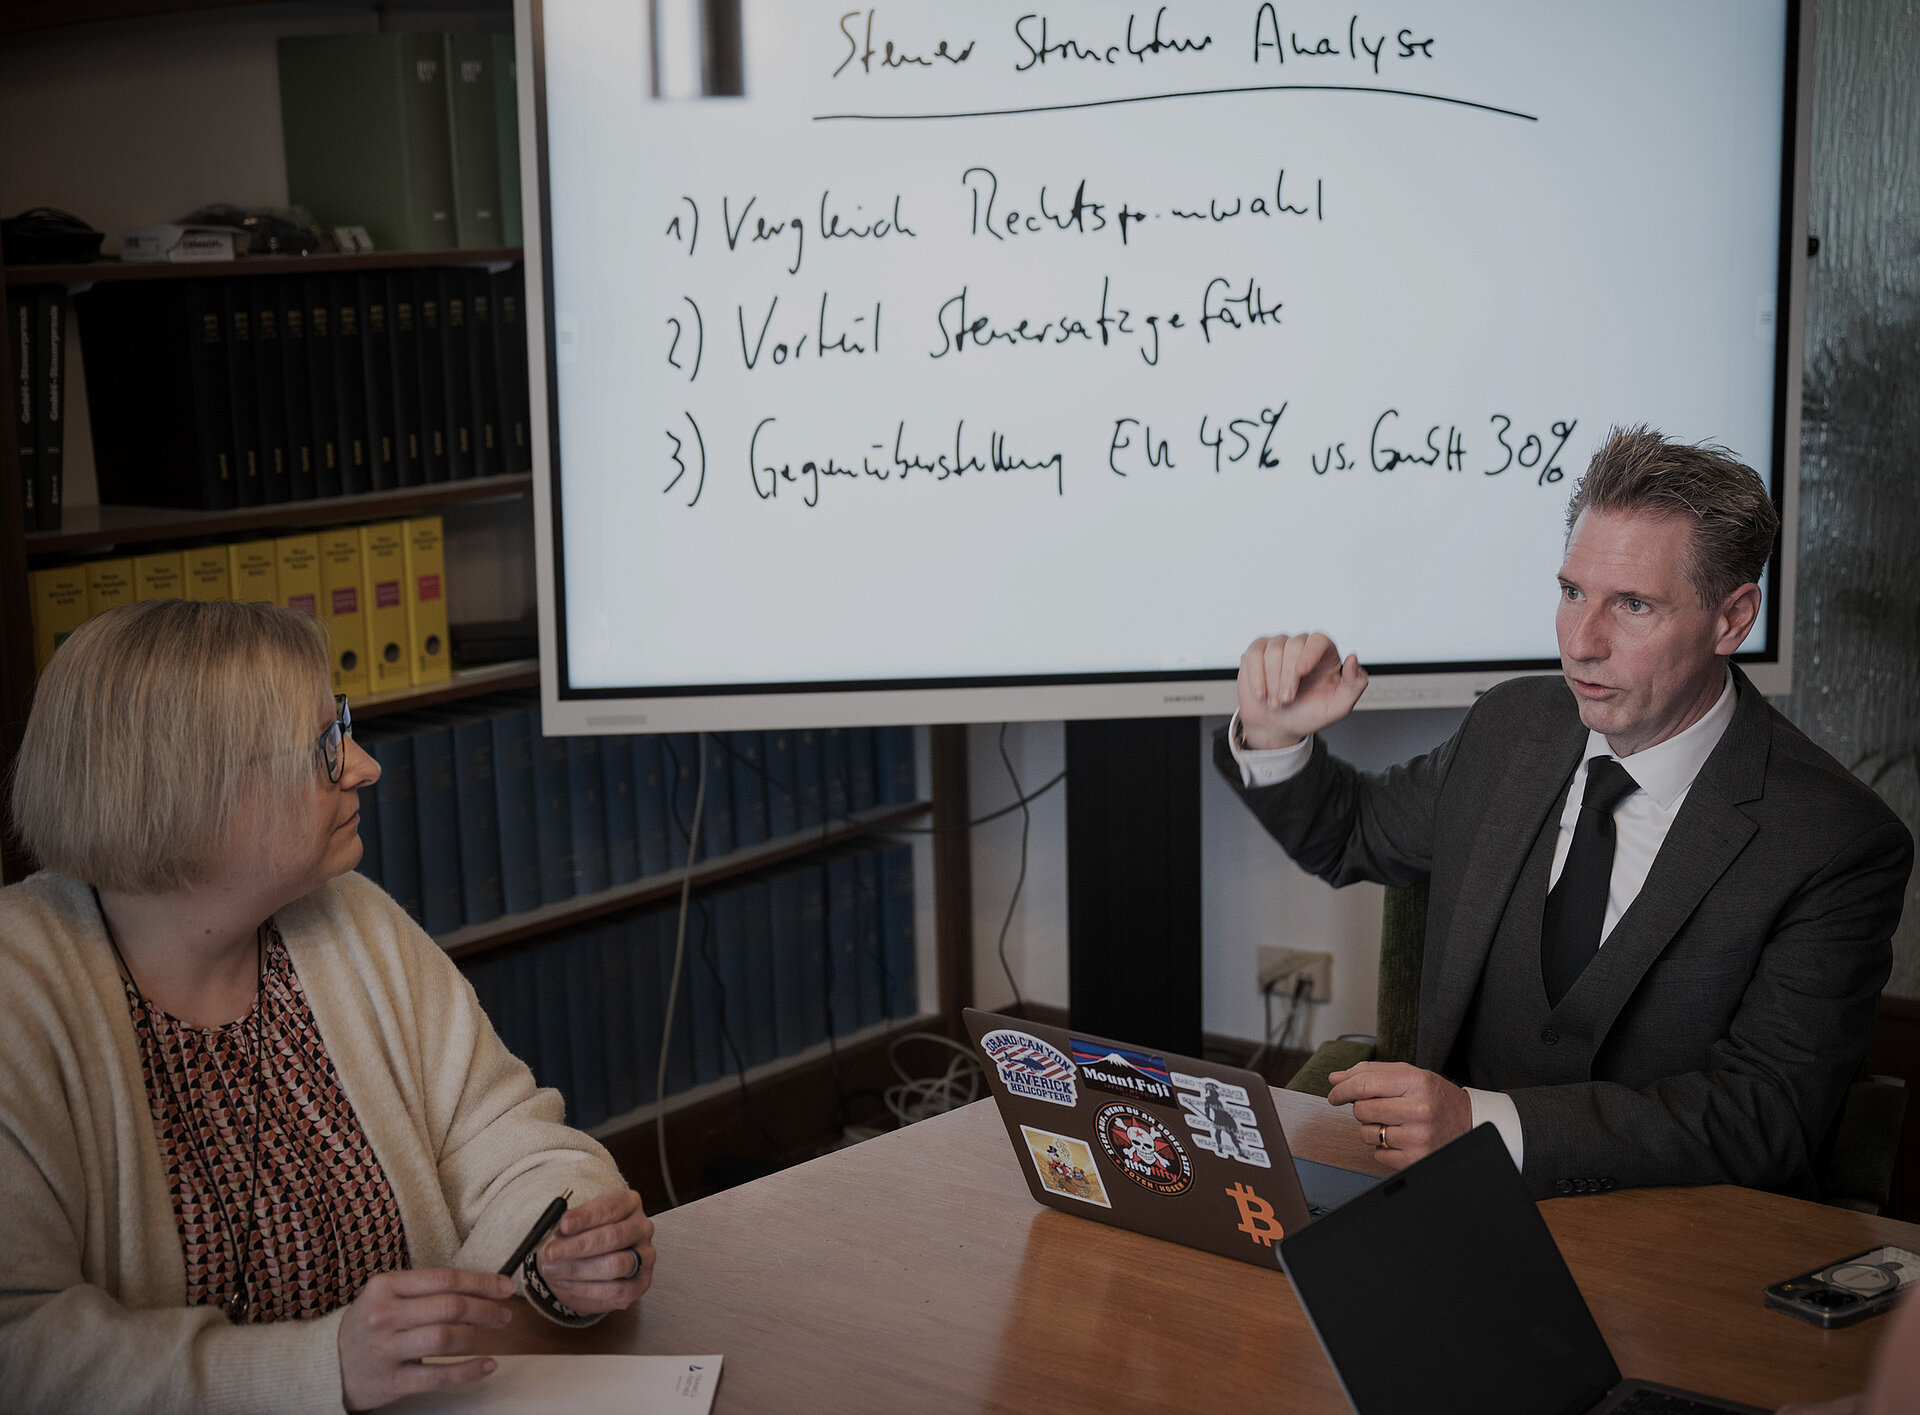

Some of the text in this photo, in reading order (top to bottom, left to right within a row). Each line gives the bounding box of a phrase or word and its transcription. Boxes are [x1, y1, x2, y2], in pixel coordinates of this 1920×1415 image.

[832, 8, 976, 79] Steuer
[1253, 1, 1435, 75] Analyse
[665, 195, 700, 257] 1)
[722, 190, 917, 276] Vergleich
[666, 295, 704, 383] 2)
[738, 291, 881, 371] Vorteil
[662, 410, 707, 508] 3)
[1199, 400, 1289, 474] 45%
[1311, 442, 1356, 476] vs.
[1483, 412, 1579, 487] 30%
[986, 1034, 1071, 1072] GRAND CANYON
[1001, 1068, 1073, 1094] MAVERICK
[1010, 1082, 1072, 1103] HELICOPTERS
[1099, 1132, 1115, 1155] STEH
[1125, 1106, 1139, 1116] DU
[1141, 1112, 1156, 1124] AM
[1156, 1123, 1185, 1154] BODEN
[1180, 1155, 1191, 1177] BIST
[1123, 1167, 1185, 1192] TOTEN HOSEN
